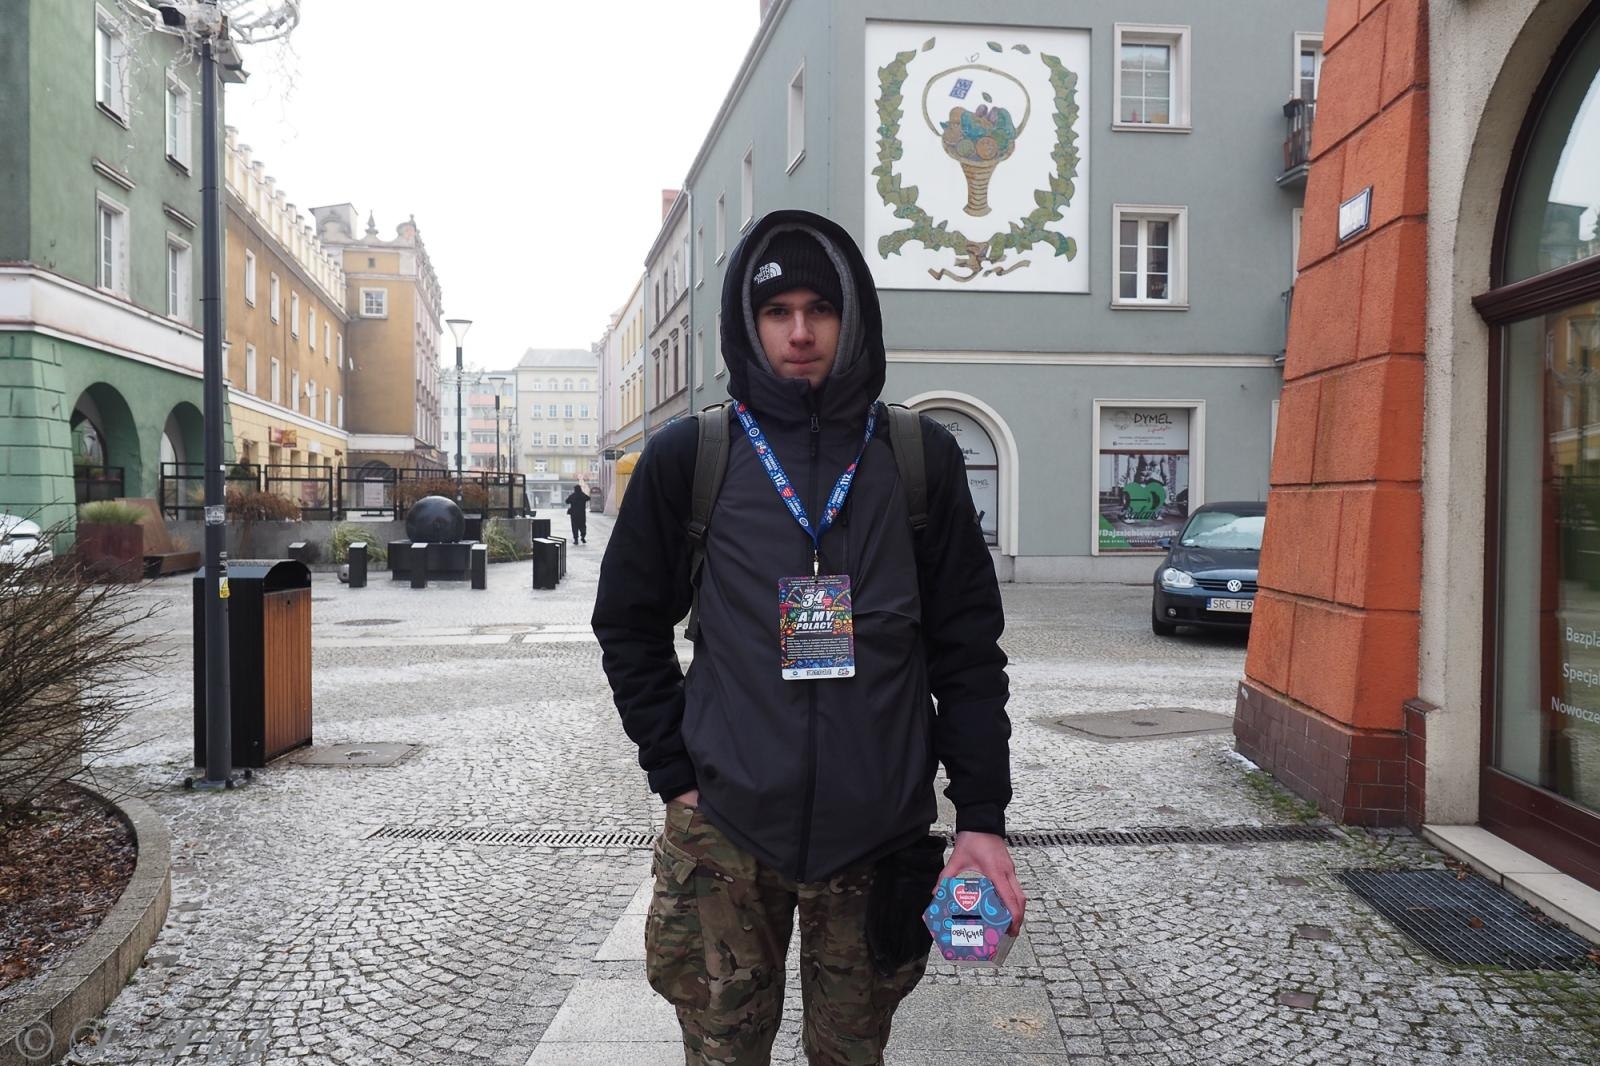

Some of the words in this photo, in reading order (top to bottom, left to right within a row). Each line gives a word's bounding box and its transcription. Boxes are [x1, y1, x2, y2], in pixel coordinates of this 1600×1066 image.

[1134, 412, 1173, 424] DYMEL
[773, 472, 786, 486] 112
[840, 474, 852, 486] 112
[802, 590, 826, 607] 34
[1213, 600, 1232, 608] SRC
[1236, 600, 1253, 610] TE9
[798, 611, 808, 622] A
